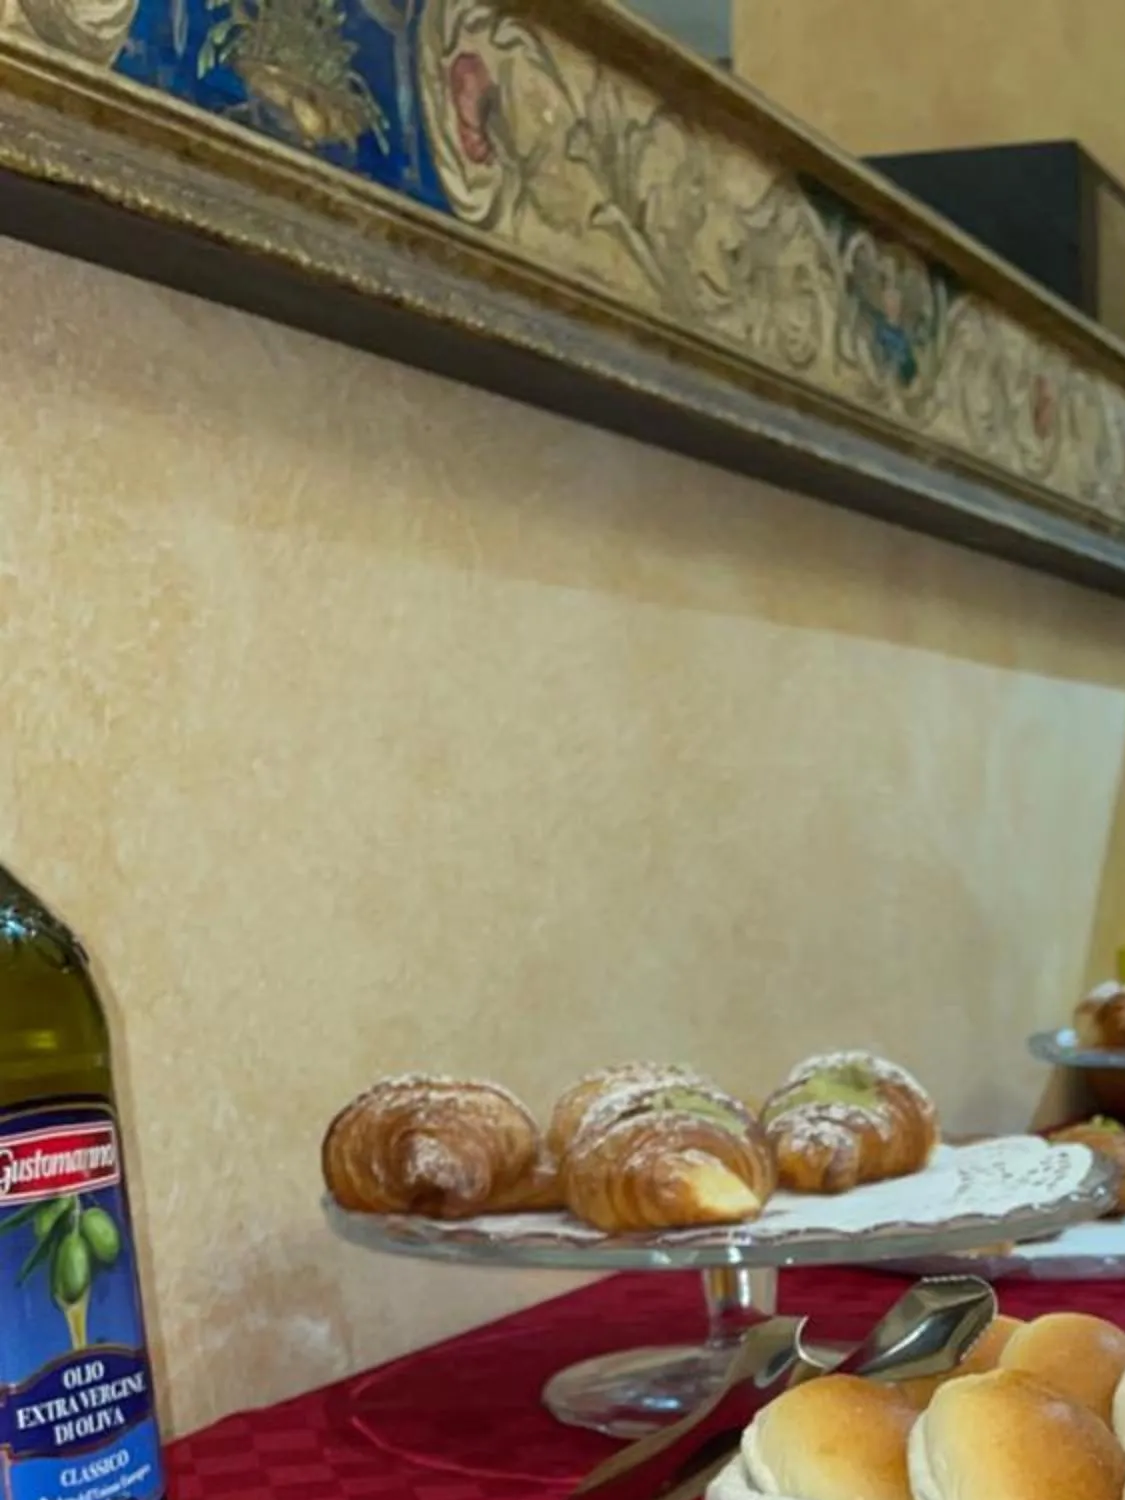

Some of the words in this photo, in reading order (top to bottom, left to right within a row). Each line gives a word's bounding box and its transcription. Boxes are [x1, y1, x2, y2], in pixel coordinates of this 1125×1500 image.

[62, 1360, 105, 1389] OLIO
[16, 1396, 79, 1429] EXTRA
[79, 1372, 146, 1409] VERGINE
[53, 1420, 75, 1446] DI
[75, 1406, 125, 1438] OLIVA
[60, 1448, 130, 1487] CLASSICO
